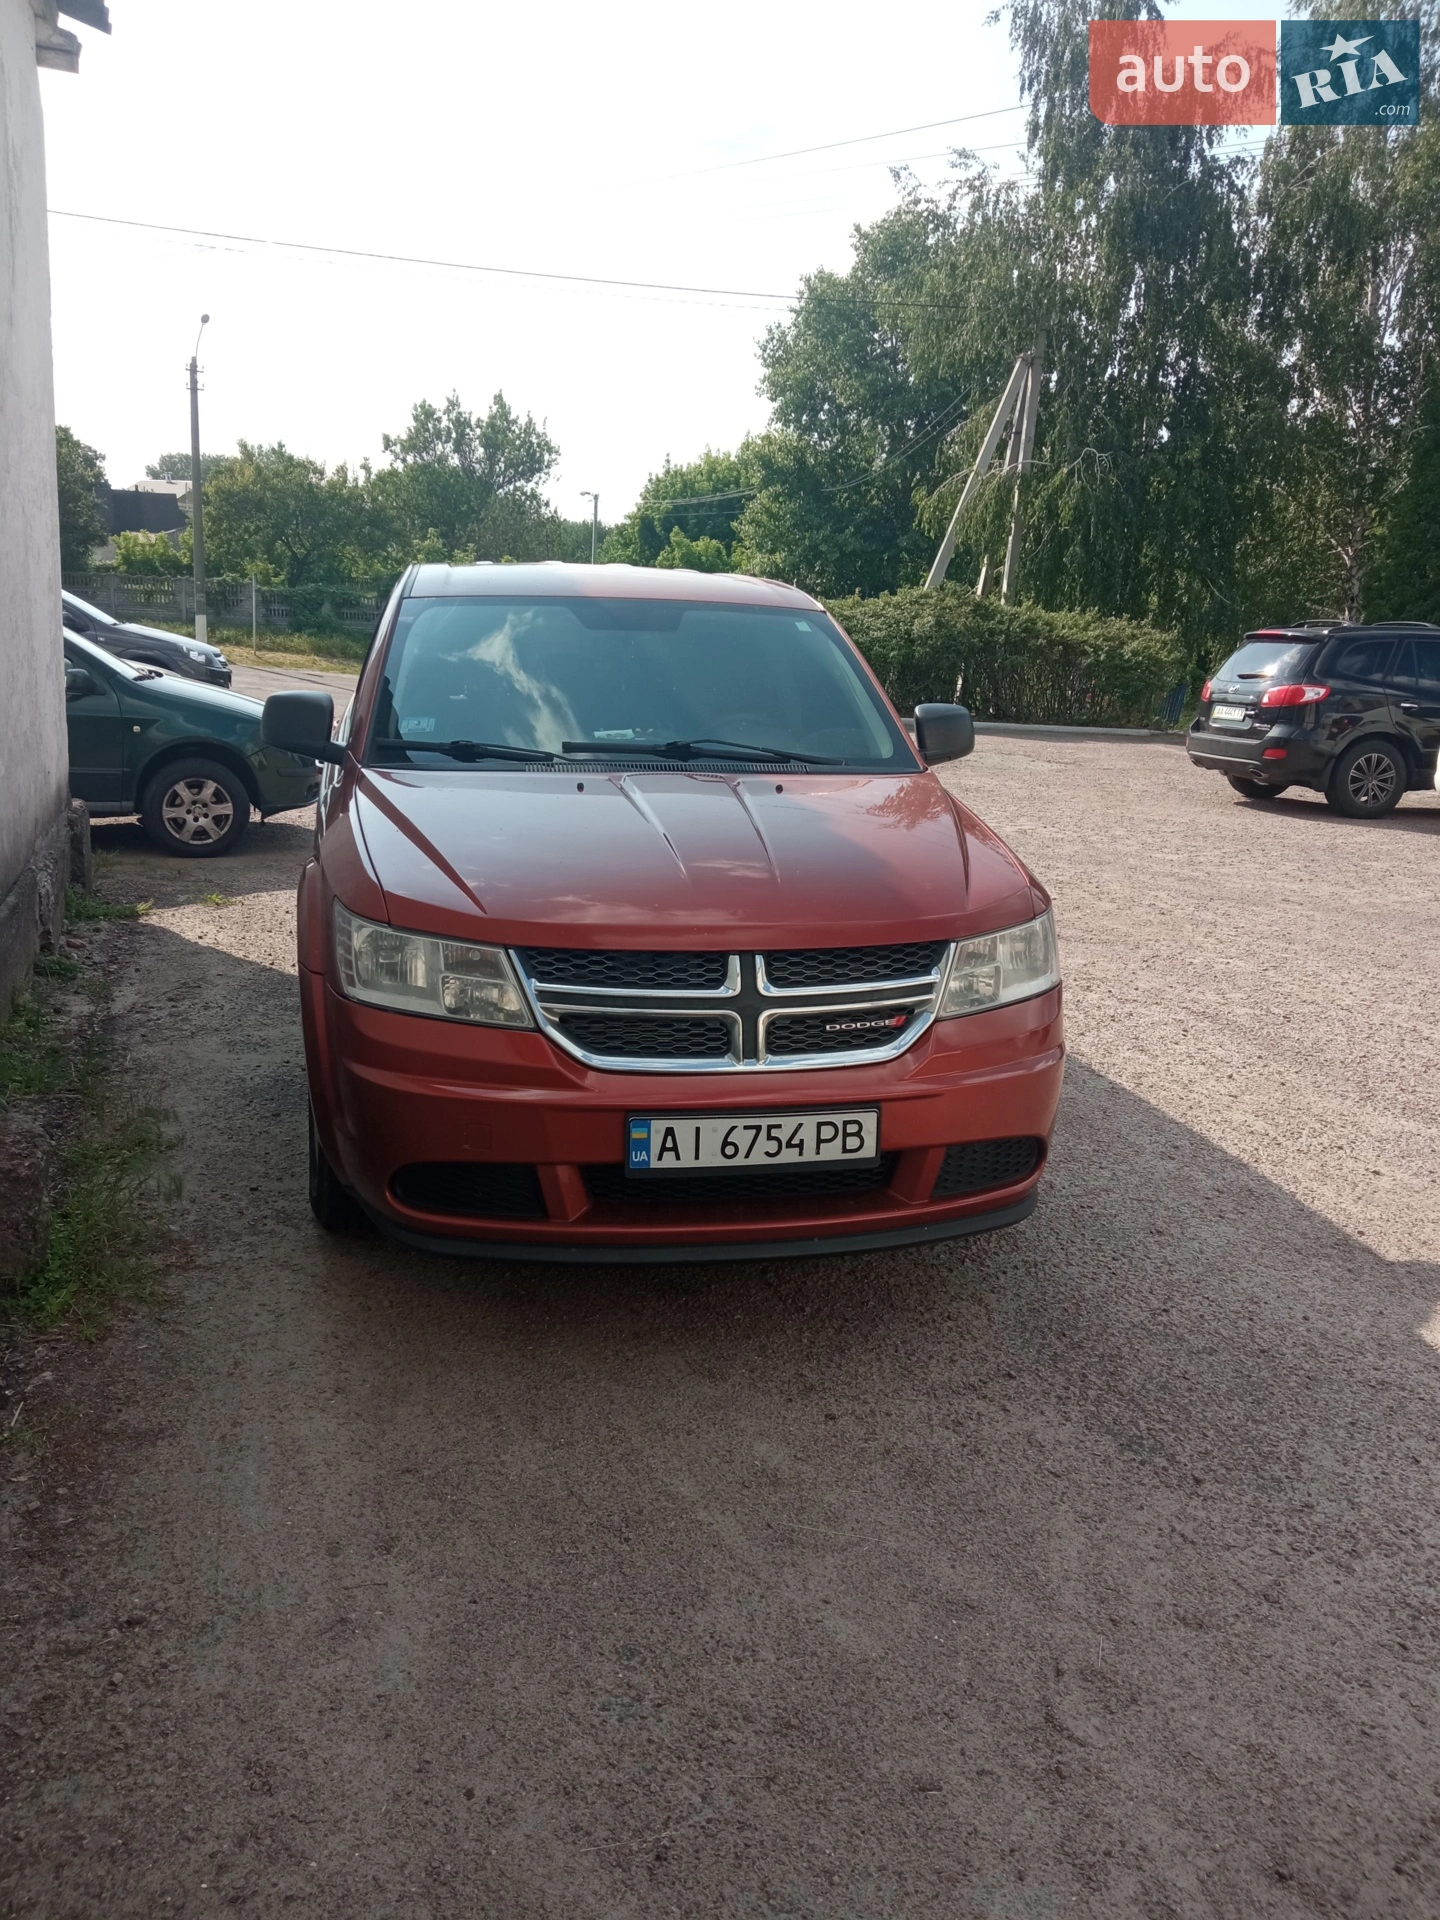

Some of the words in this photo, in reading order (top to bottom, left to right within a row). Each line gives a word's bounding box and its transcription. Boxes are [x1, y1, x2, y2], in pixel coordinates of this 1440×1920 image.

[825, 1019, 897, 1031] DODGE
[720, 1122, 805, 1160] 6754
[815, 1119, 865, 1156] PB
[632, 1151, 649, 1162] UA
